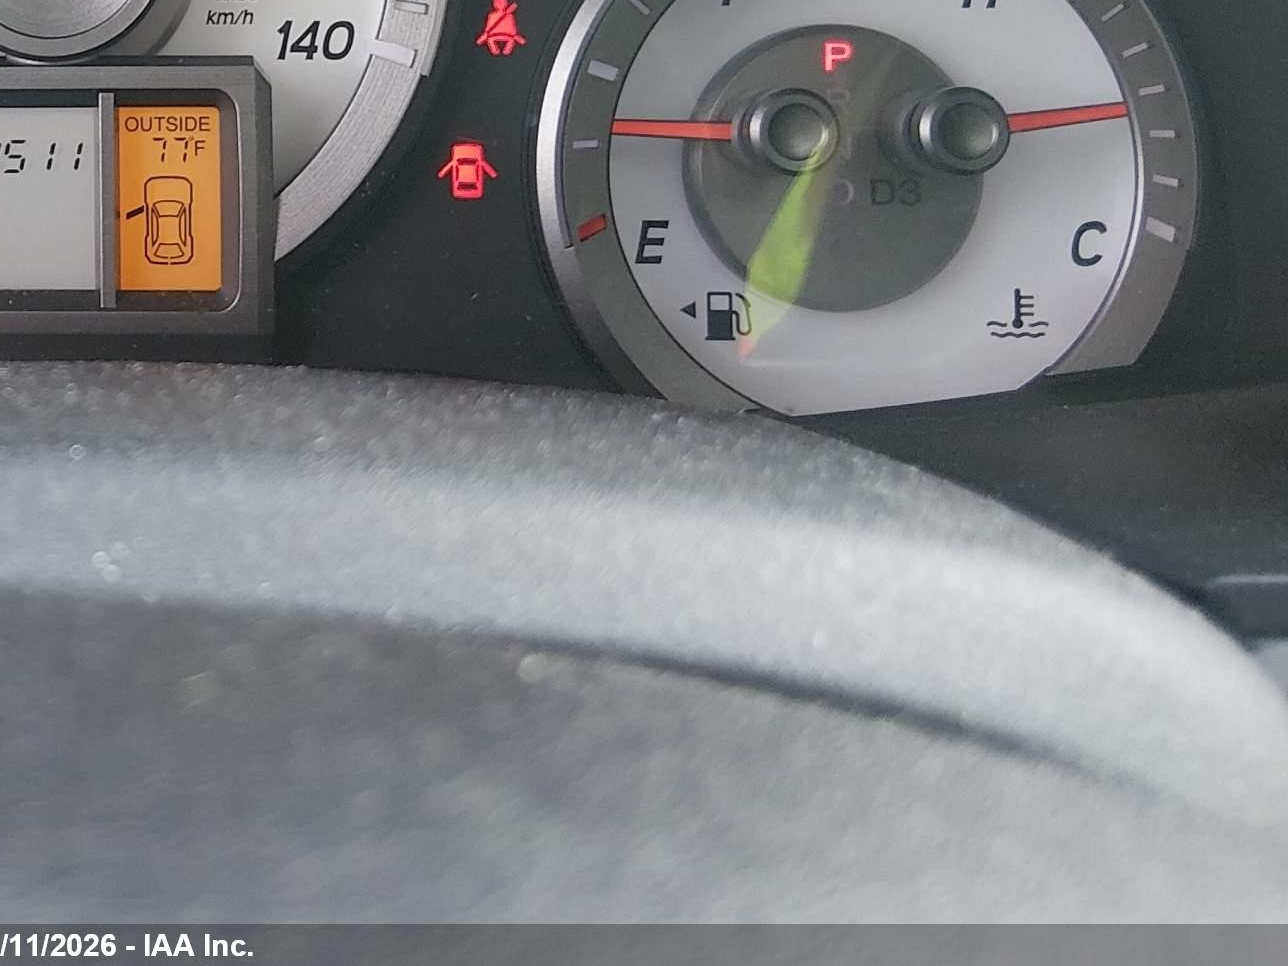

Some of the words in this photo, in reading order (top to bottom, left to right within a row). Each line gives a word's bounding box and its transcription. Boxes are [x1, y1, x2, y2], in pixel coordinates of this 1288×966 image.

[206, 9, 254, 26] km/h
[277, 20, 356, 60] 140
[823, 40, 853, 72] P
[124, 116, 211, 133] OUTSIDE
[635, 219, 669, 265] E
[1070, 221, 1108, 267] C
